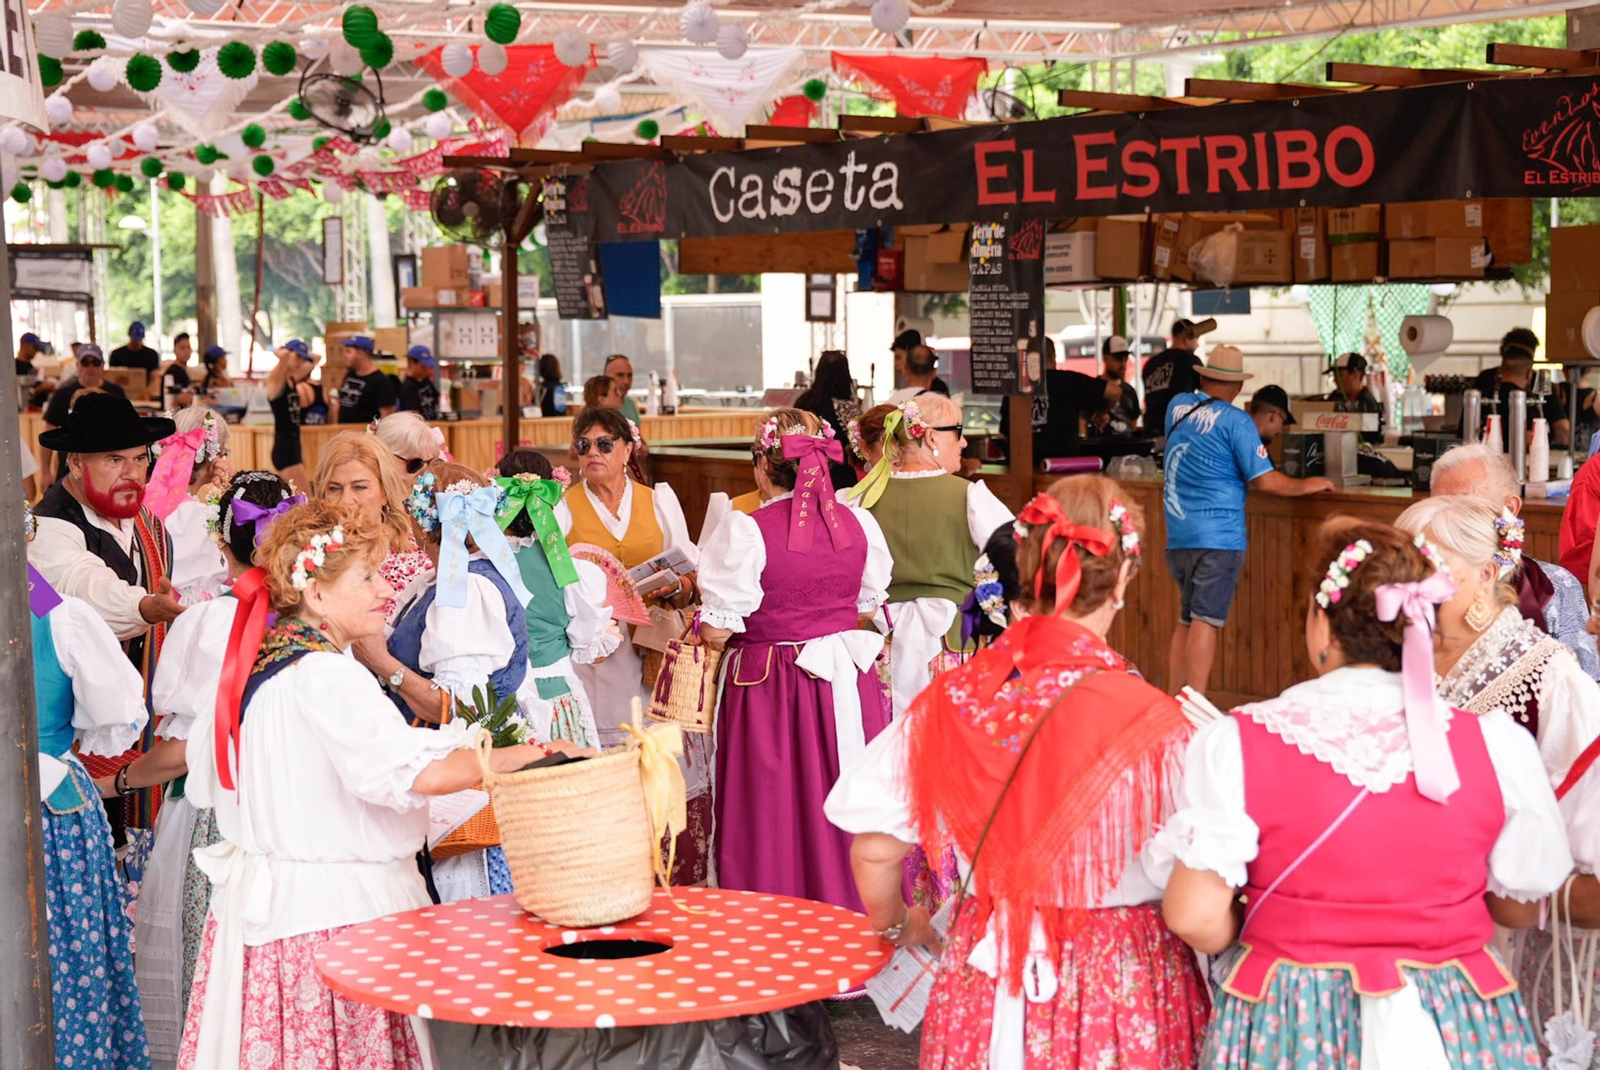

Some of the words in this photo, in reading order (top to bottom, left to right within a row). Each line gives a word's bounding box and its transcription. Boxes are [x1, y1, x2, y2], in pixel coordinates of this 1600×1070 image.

[708, 150, 904, 224] Caseta
[973, 138, 1056, 207] EL
[1072, 125, 1376, 202] ESTRIBO
[1524, 170, 1545, 185] EL
[1549, 169, 1600, 184] ESTRIB
[971, 263, 1002, 275] TAPAS
